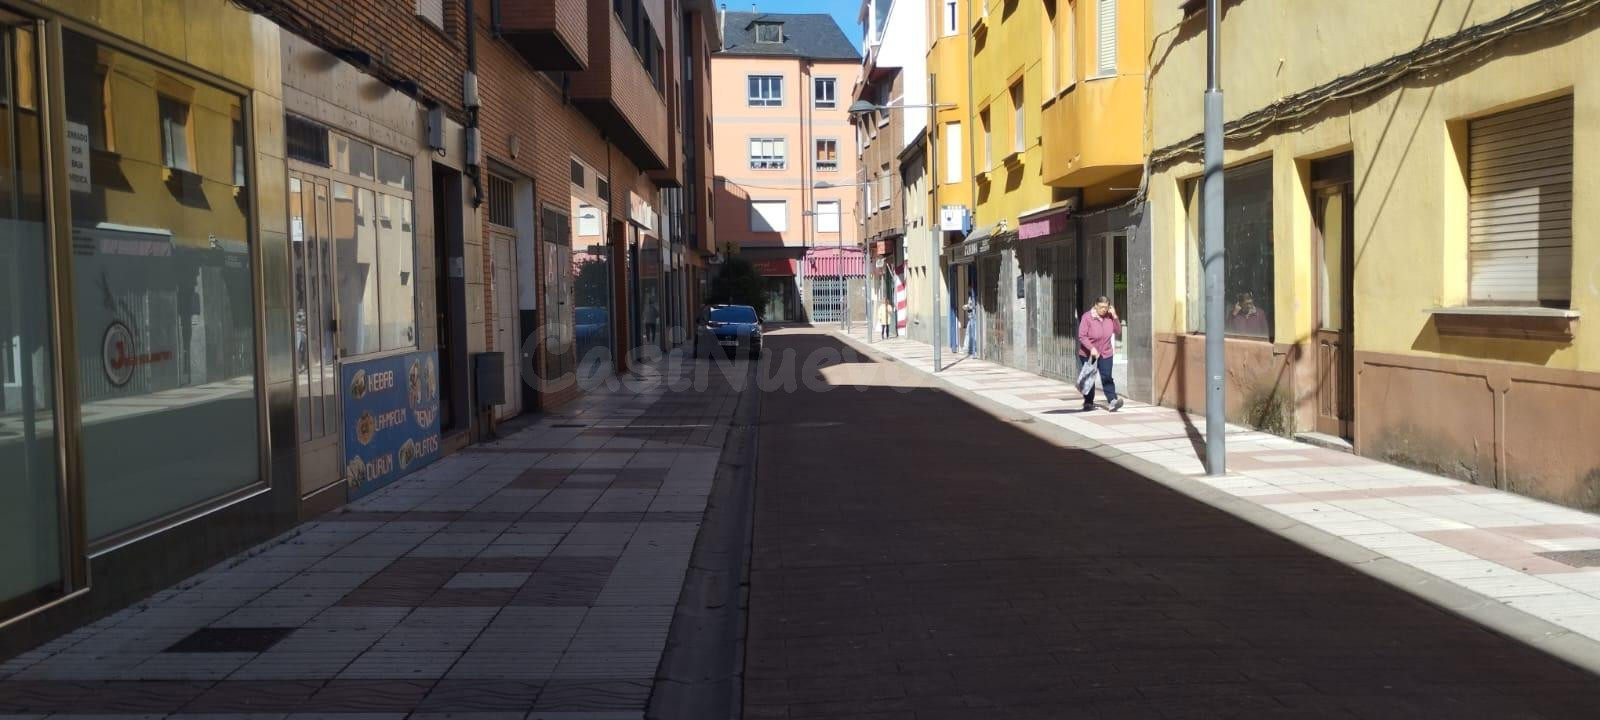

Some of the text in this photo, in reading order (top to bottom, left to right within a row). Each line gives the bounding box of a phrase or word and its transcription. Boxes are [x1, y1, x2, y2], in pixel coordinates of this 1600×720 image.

[368, 370, 394, 393] KEBAB
[414, 434, 438, 459] PLATOS
[366, 454, 393, 481] DURUM
